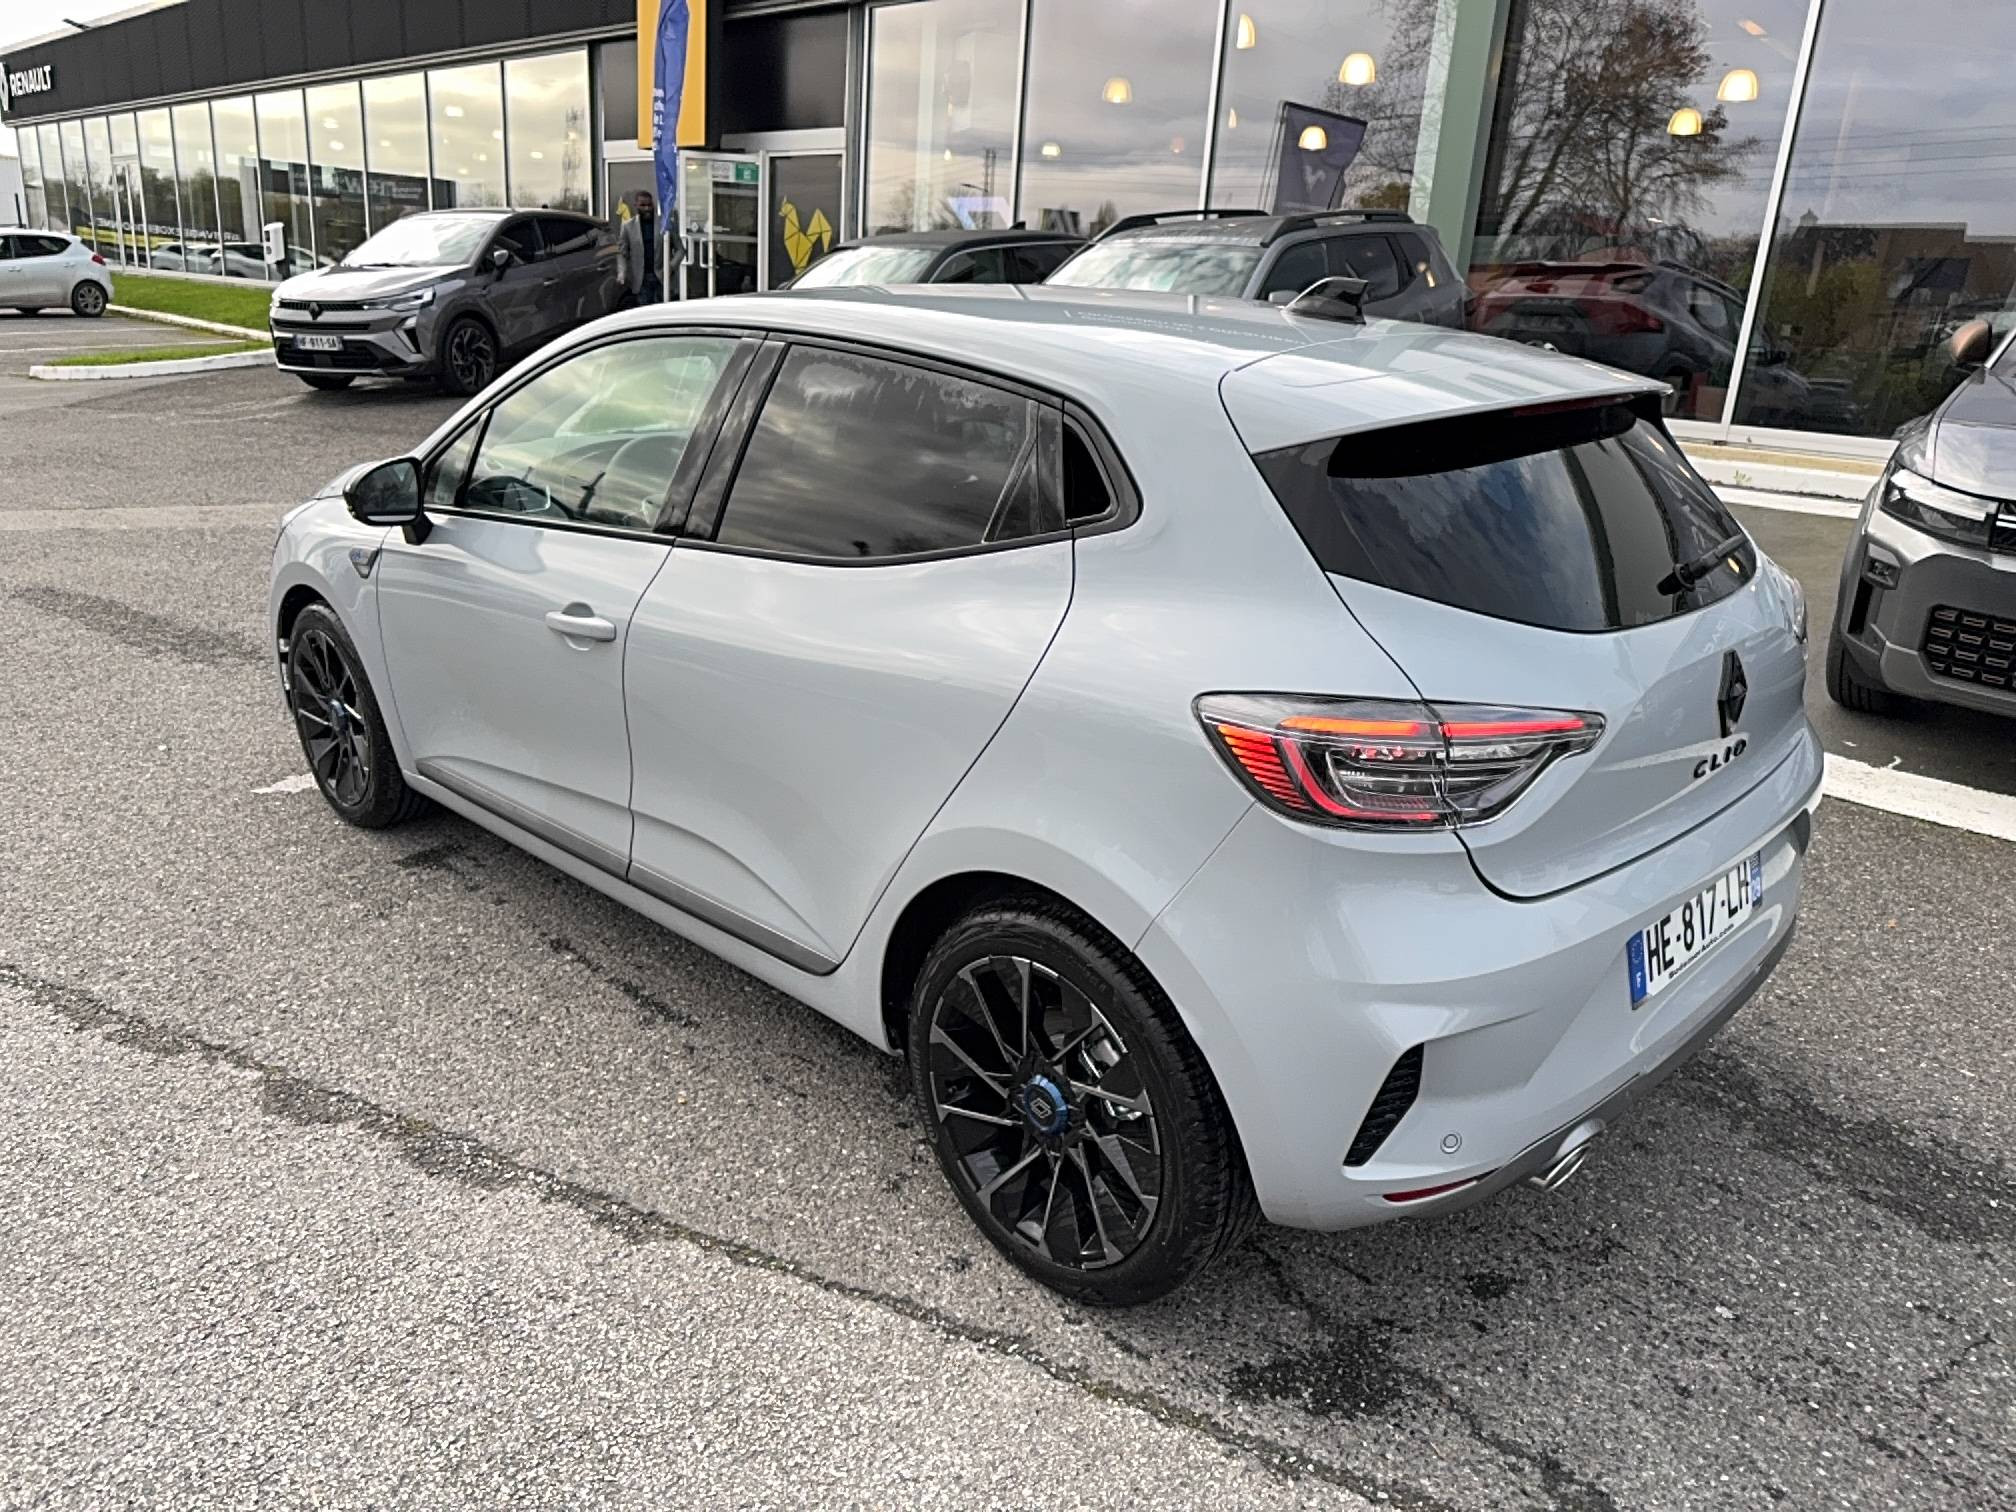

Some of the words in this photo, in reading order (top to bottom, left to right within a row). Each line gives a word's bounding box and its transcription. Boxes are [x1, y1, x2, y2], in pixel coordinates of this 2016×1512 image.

[9, 65, 51, 96] RENAULT
[1693, 739, 1747, 779] CLIO
[1646, 860, 1749, 982] HE-817-LH
